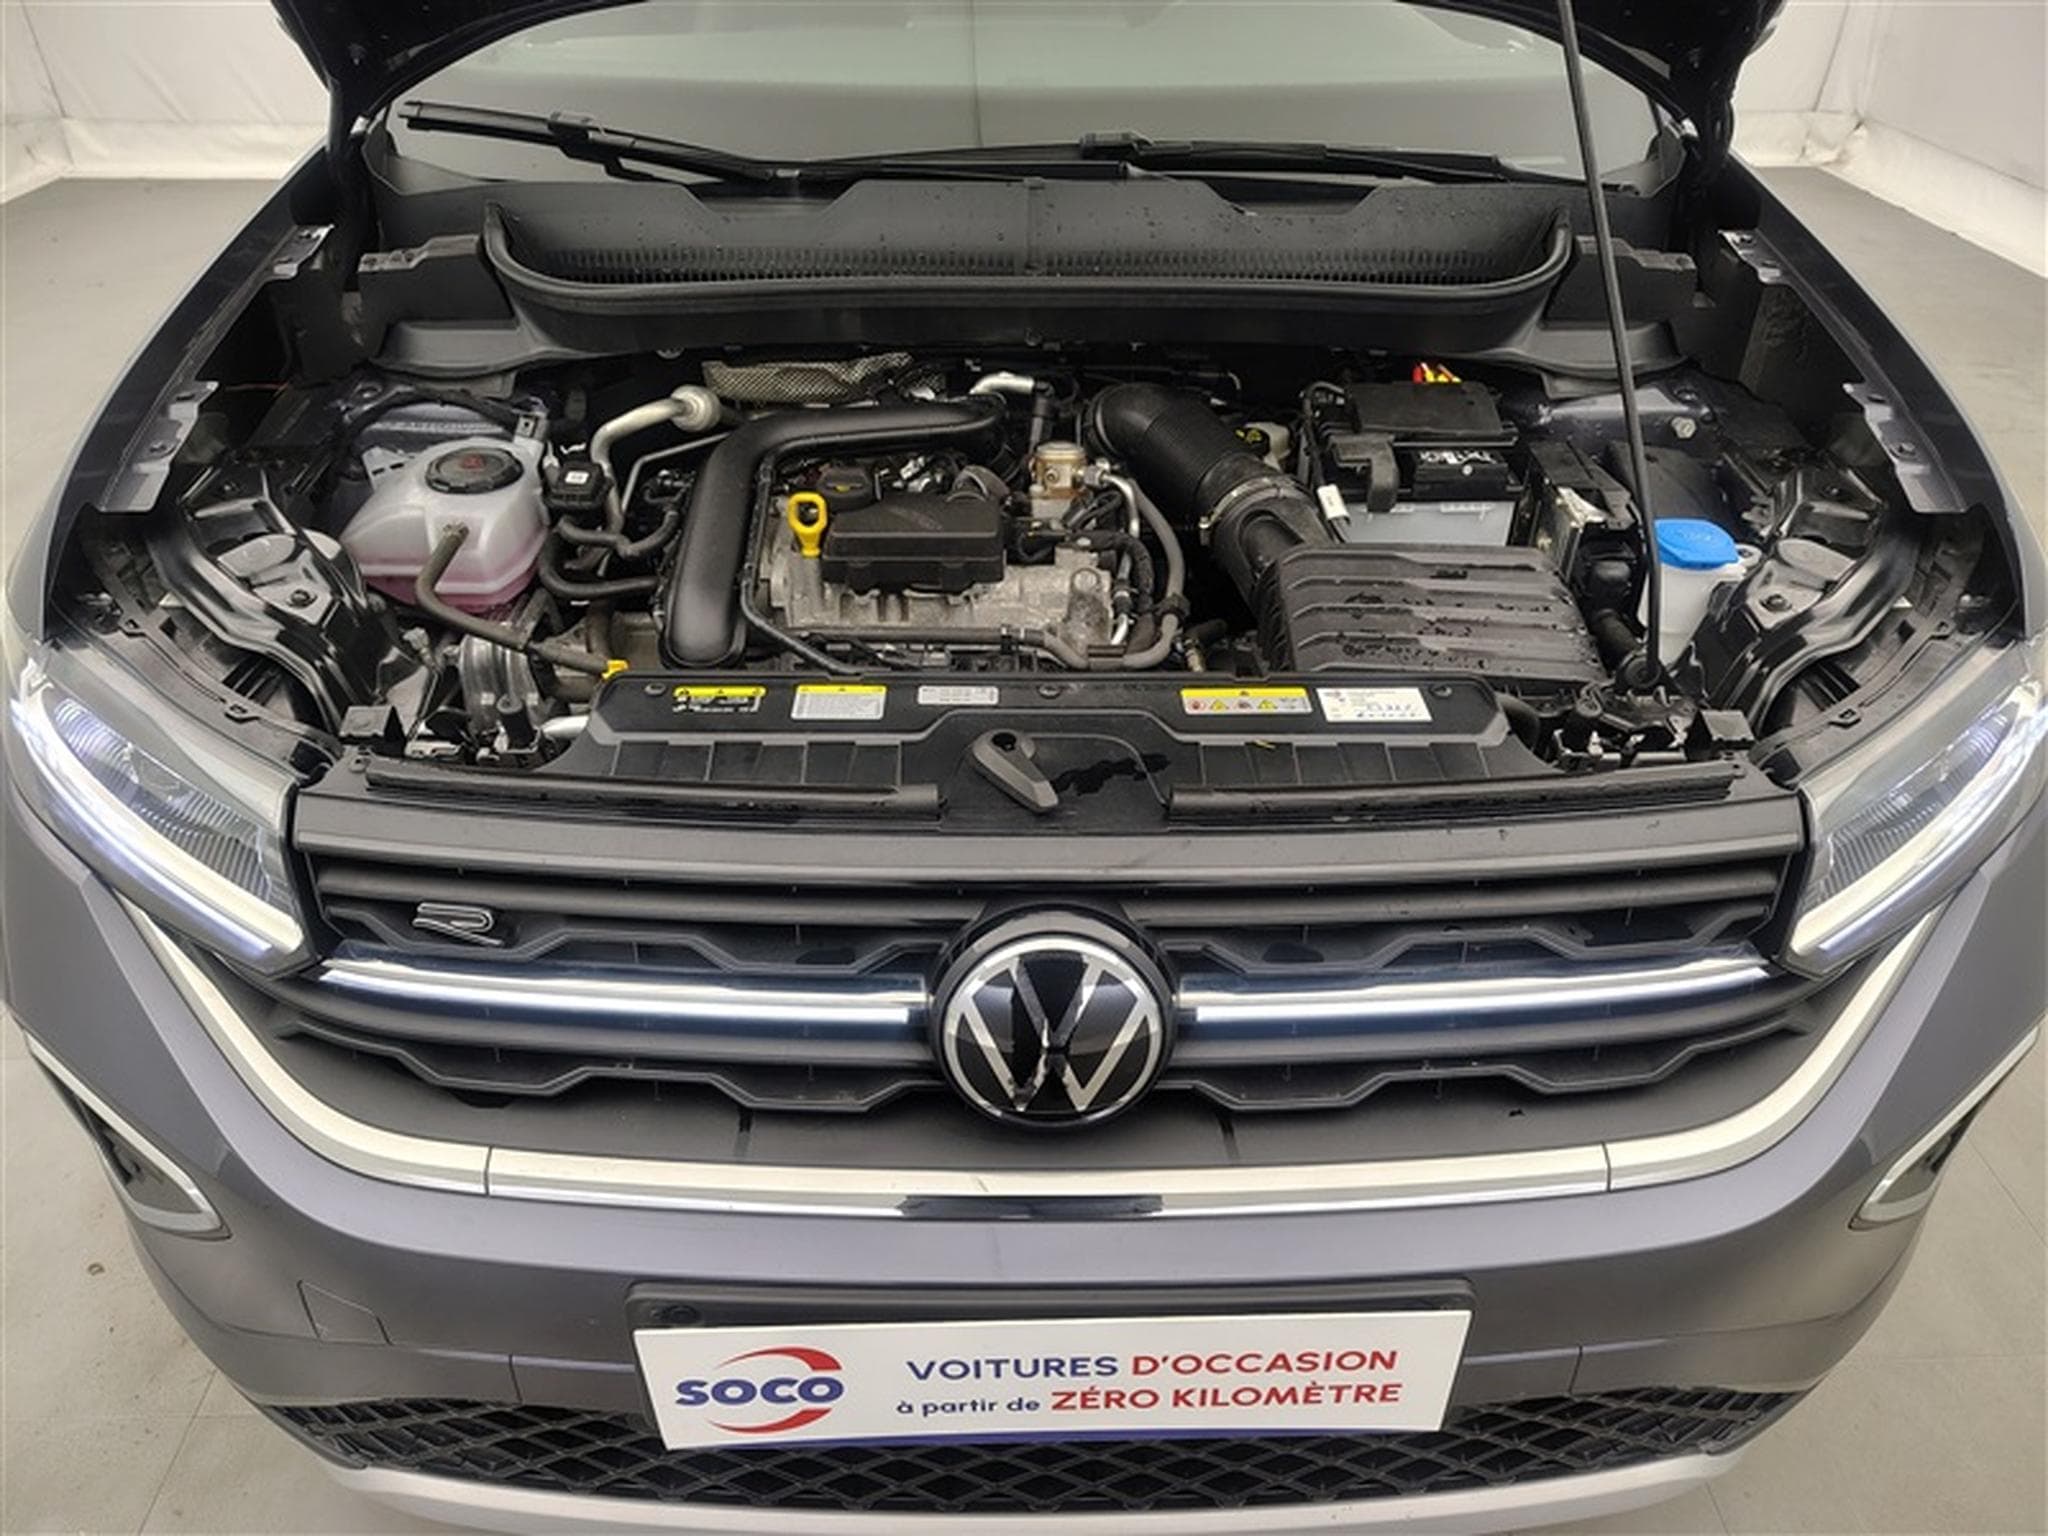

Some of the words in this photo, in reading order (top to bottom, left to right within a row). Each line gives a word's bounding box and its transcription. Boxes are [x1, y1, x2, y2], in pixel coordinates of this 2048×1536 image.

[907, 1356, 1118, 1380] VOITURES
[675, 1376, 844, 1406] SOCO
[896, 1396, 914, 1414] à
[921, 1397, 998, 1417] partir
[1005, 1396, 1041, 1412] de
[1051, 1383, 1160, 1410] ZÉRO
[1171, 1379, 1403, 1408] KILOMÈTRE
